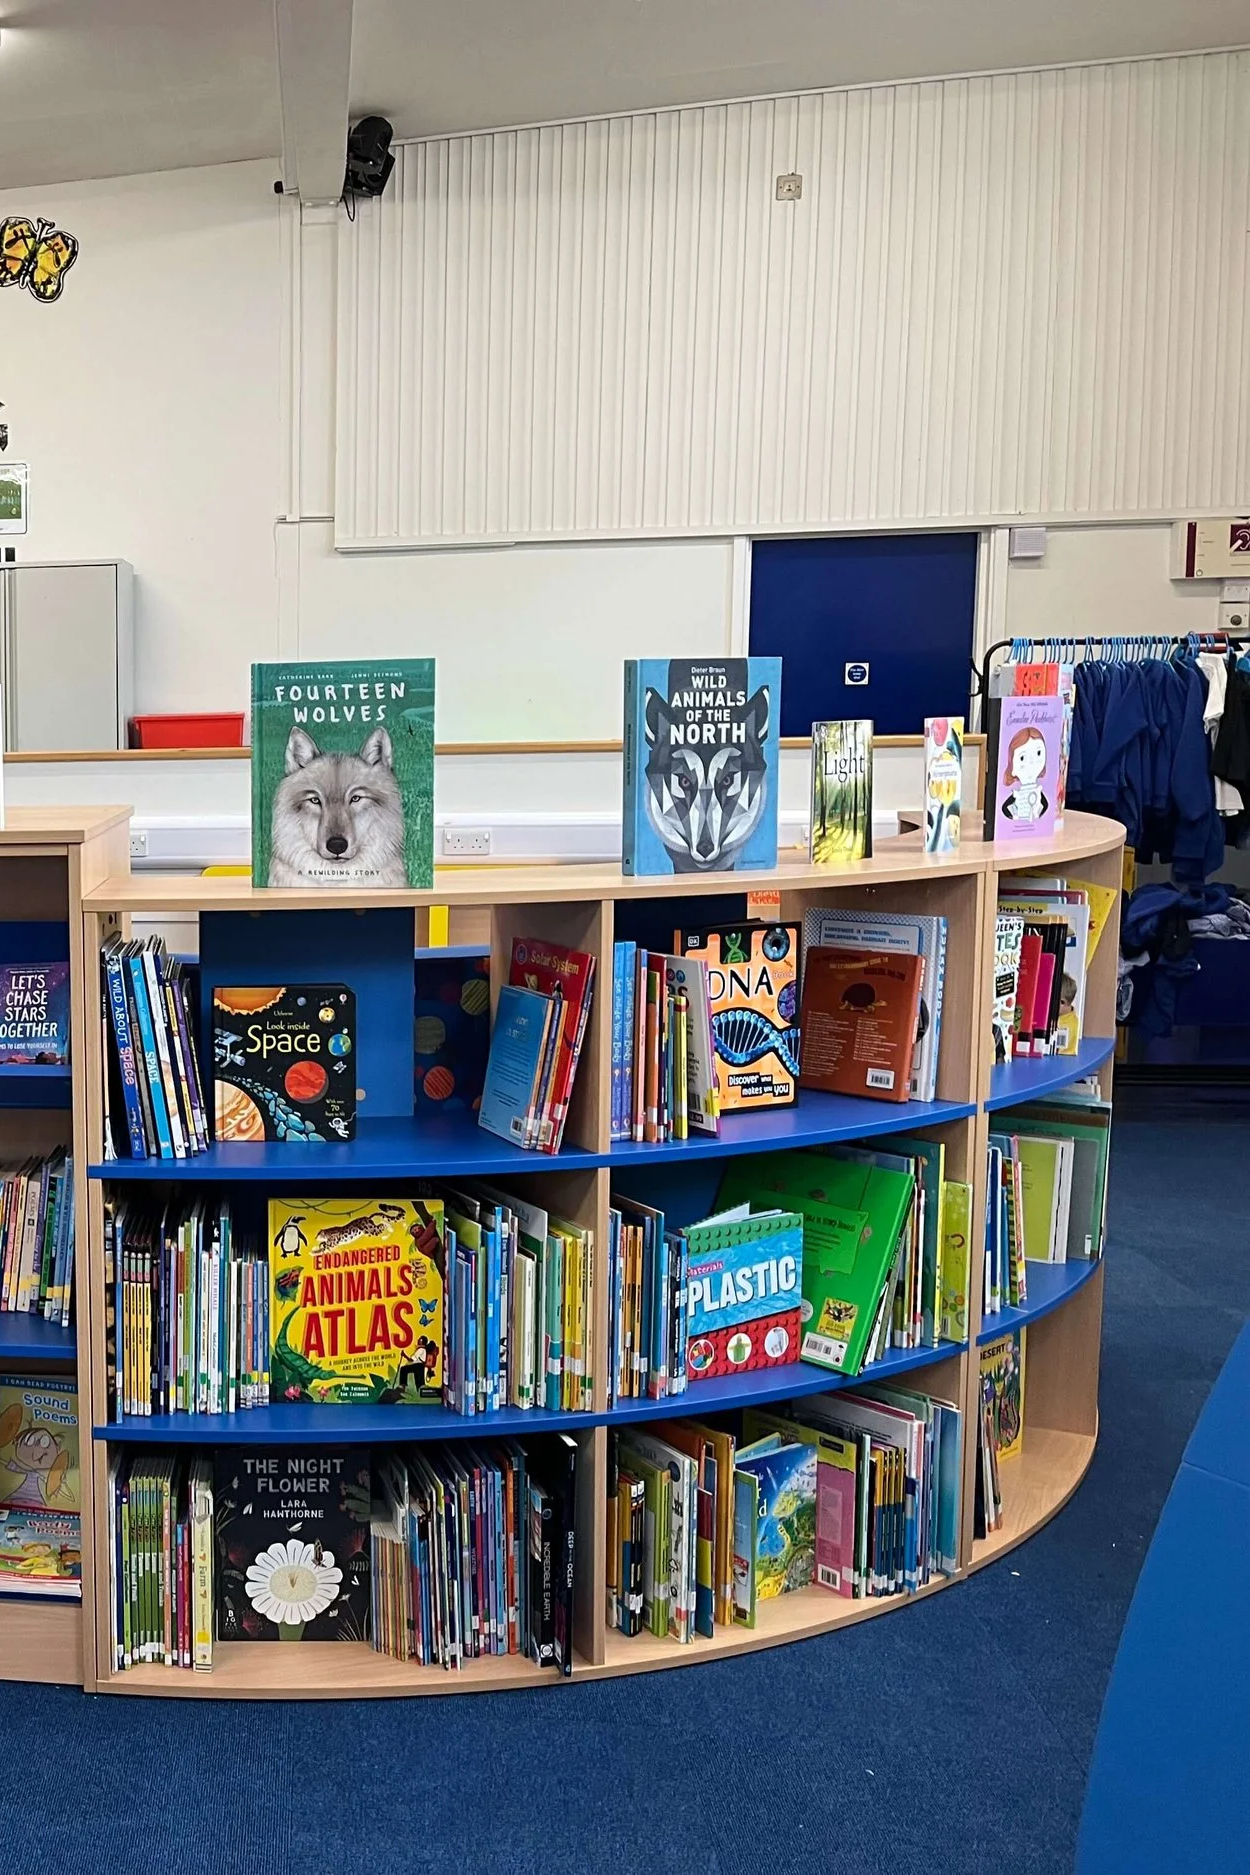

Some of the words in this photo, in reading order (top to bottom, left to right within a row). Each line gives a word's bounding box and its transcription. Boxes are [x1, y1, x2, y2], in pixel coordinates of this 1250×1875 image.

[691, 666, 707, 674] Dieter
[691, 675, 727, 689] WILD
[275, 682, 406, 702] FOURTEEN
[671, 691, 746, 708] ANIMALS
[293, 705, 387, 723] WOLVES
[686, 710, 702, 722] OF
[706, 709, 731, 721] THE
[669, 722, 746, 745] NORTH
[823, 747, 866, 784] Light
[999, 905, 1044, 914] Step-by-Step
[530, 951, 550, 965] Solar
[551, 957, 579, 975] System
[11, 975, 46, 989] LET'S
[112, 978, 123, 1004] WILD
[709, 966, 774, 1000] DNA
[6, 991, 48, 1006] CHASE
[5, 1007, 47, 1021] STARS
[114, 1006, 128, 1050] ABOUT
[266, 1021, 285, 1030] Look
[286, 1021, 310, 1030] inside
[246, 1024, 321, 1059] Space
[120, 1047, 135, 1085] Space
[145, 1051, 160, 1083] SPACE
[728, 1073, 760, 1086] Discover
[742, 1086, 763, 1096] makes
[773, 1084, 789, 1095] you
[314, 1245, 400, 1270] ENDANGERED
[302, 1264, 414, 1308] ANIMALS
[688, 1255, 797, 1317] PLASTIC
[303, 1301, 414, 1359] ATLAS
[23, 1393, 70, 1411] Sound
[33, 1409, 78, 1425] Poems
[243, 1458, 279, 1474] THE
[287, 1458, 345, 1474] NIGHT
[257, 1478, 330, 1493] FLOWER
[280, 1499, 307, 1508] LARA
[263, 1509, 324, 1519] HAWTHORNE
[199, 1565, 207, 1587] Farm
